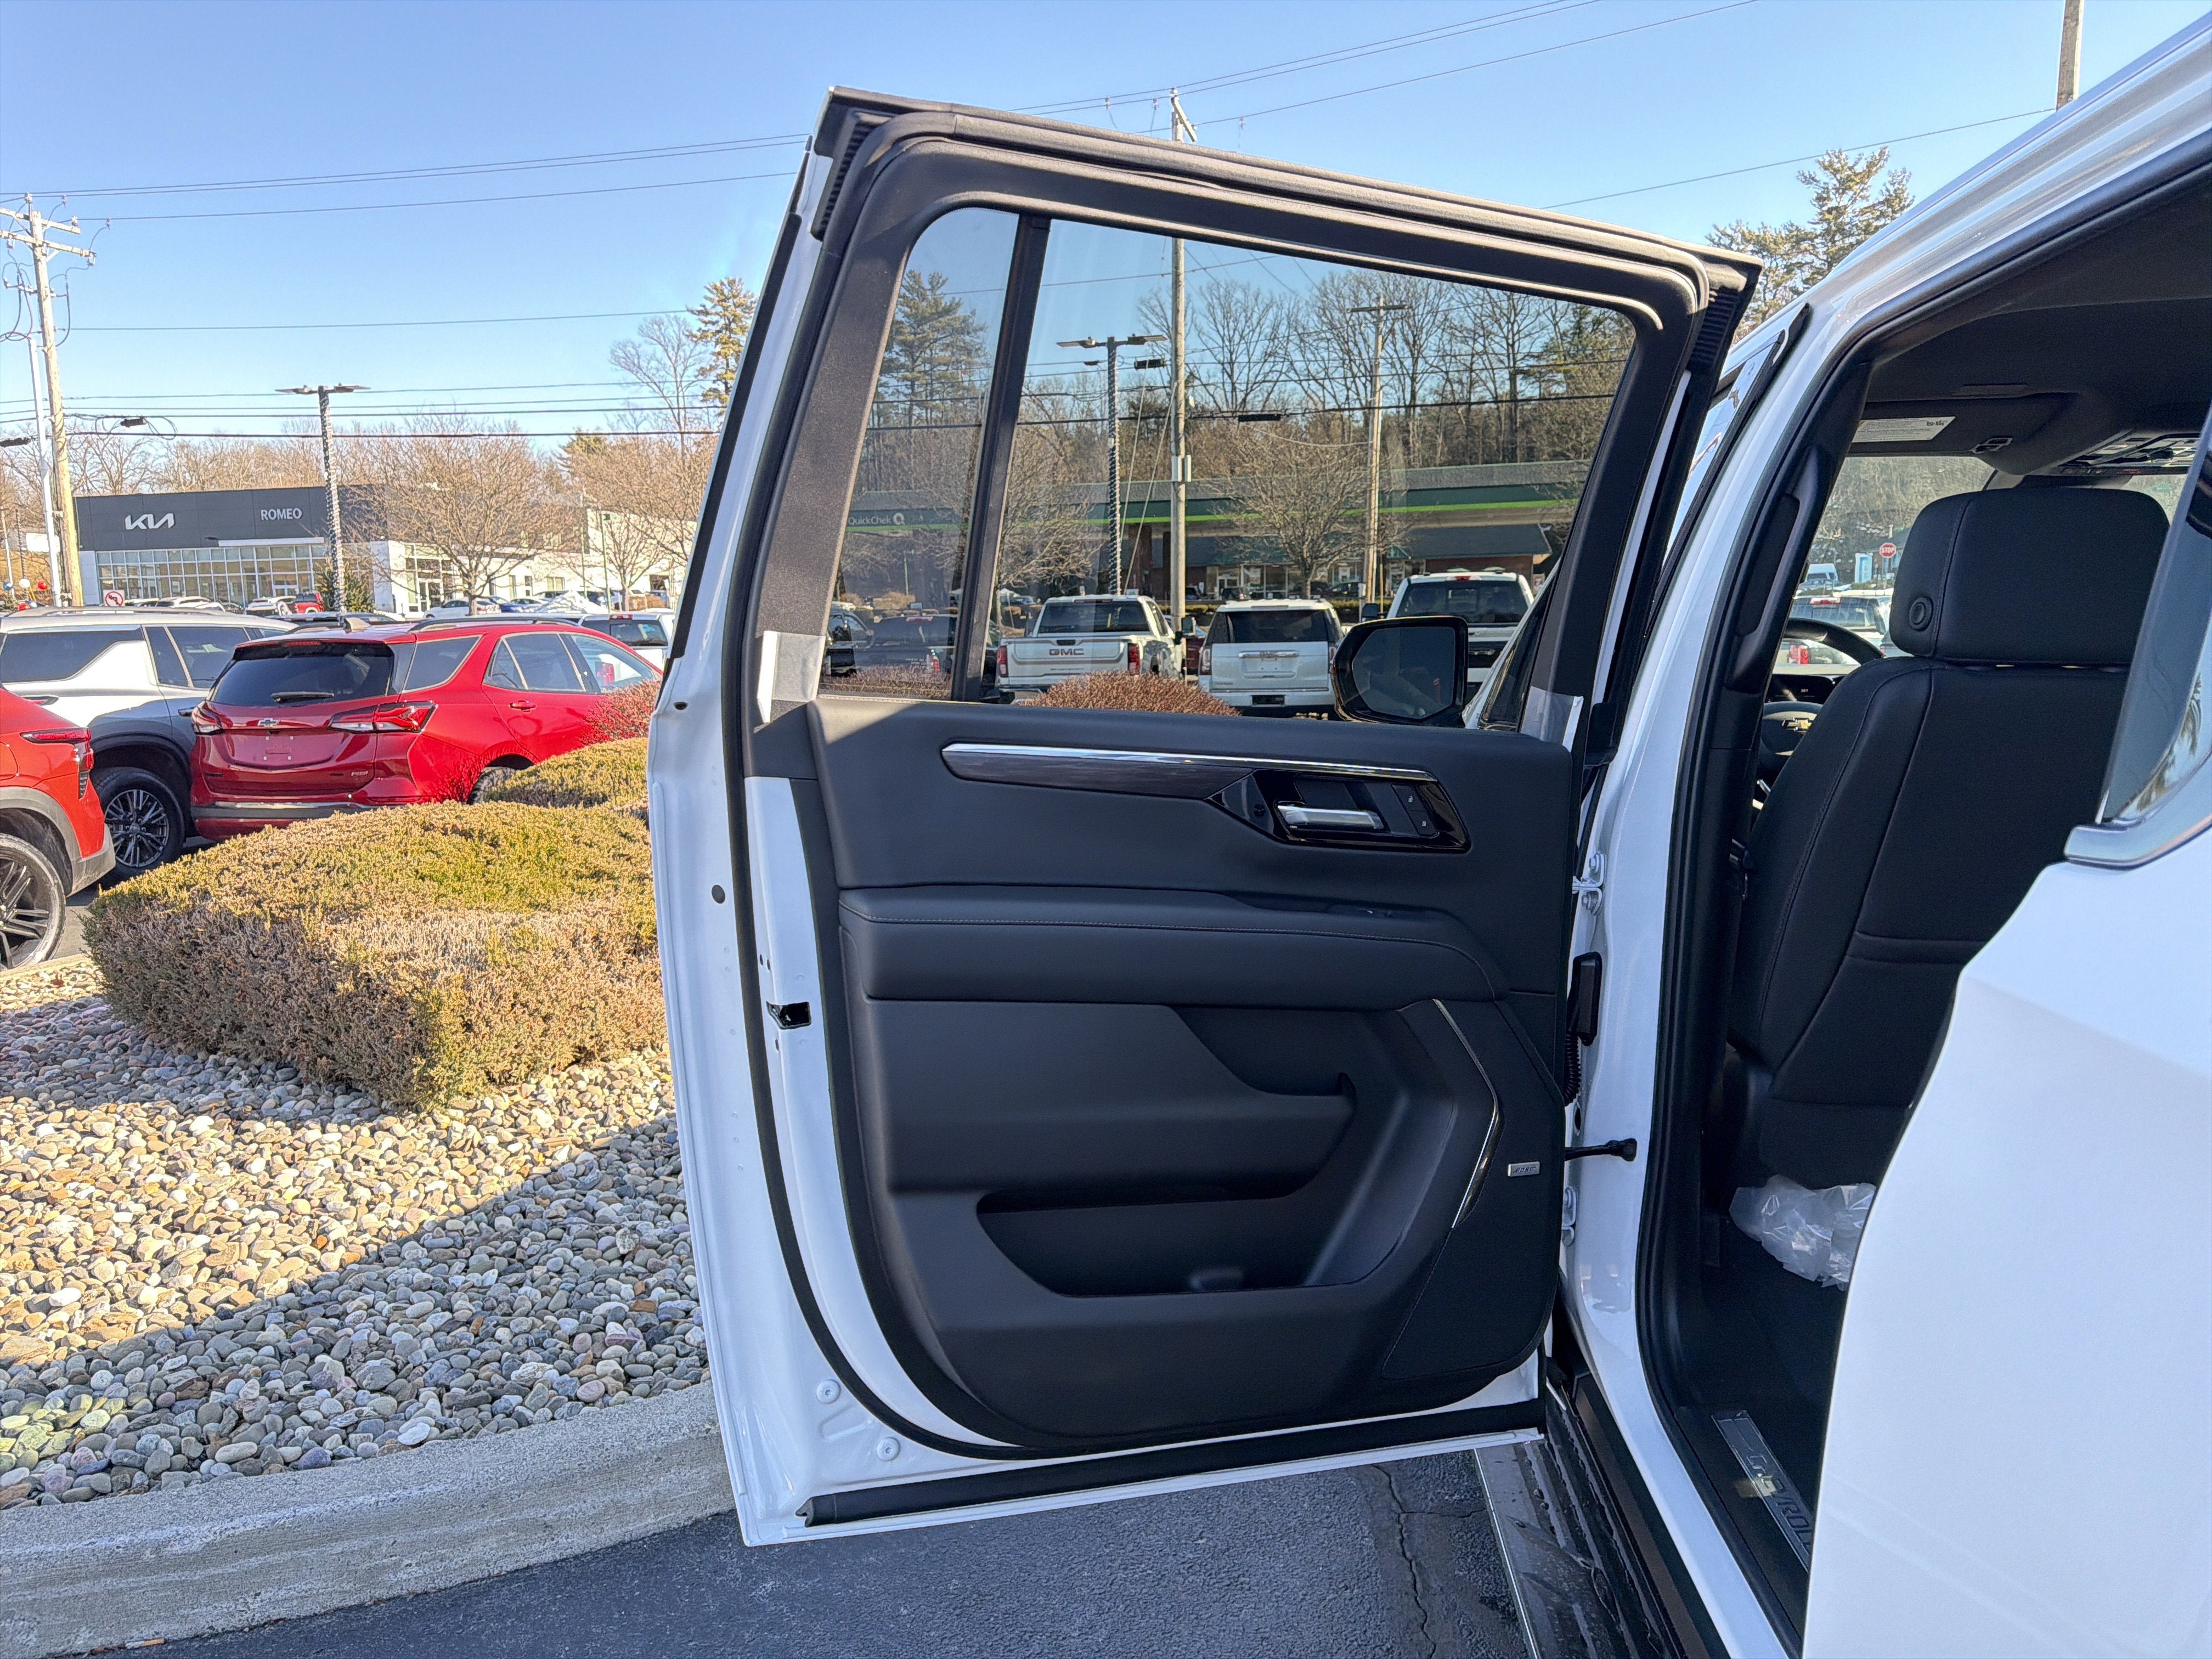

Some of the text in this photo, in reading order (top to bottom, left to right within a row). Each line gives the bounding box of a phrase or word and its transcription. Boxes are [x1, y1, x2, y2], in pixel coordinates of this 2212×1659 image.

[125, 513, 174, 530] KIA
[261, 508, 302, 521] ROMEO
[848, 516, 891, 526] QuickChek
[1746, 1455, 1812, 1554] CHEVROL
